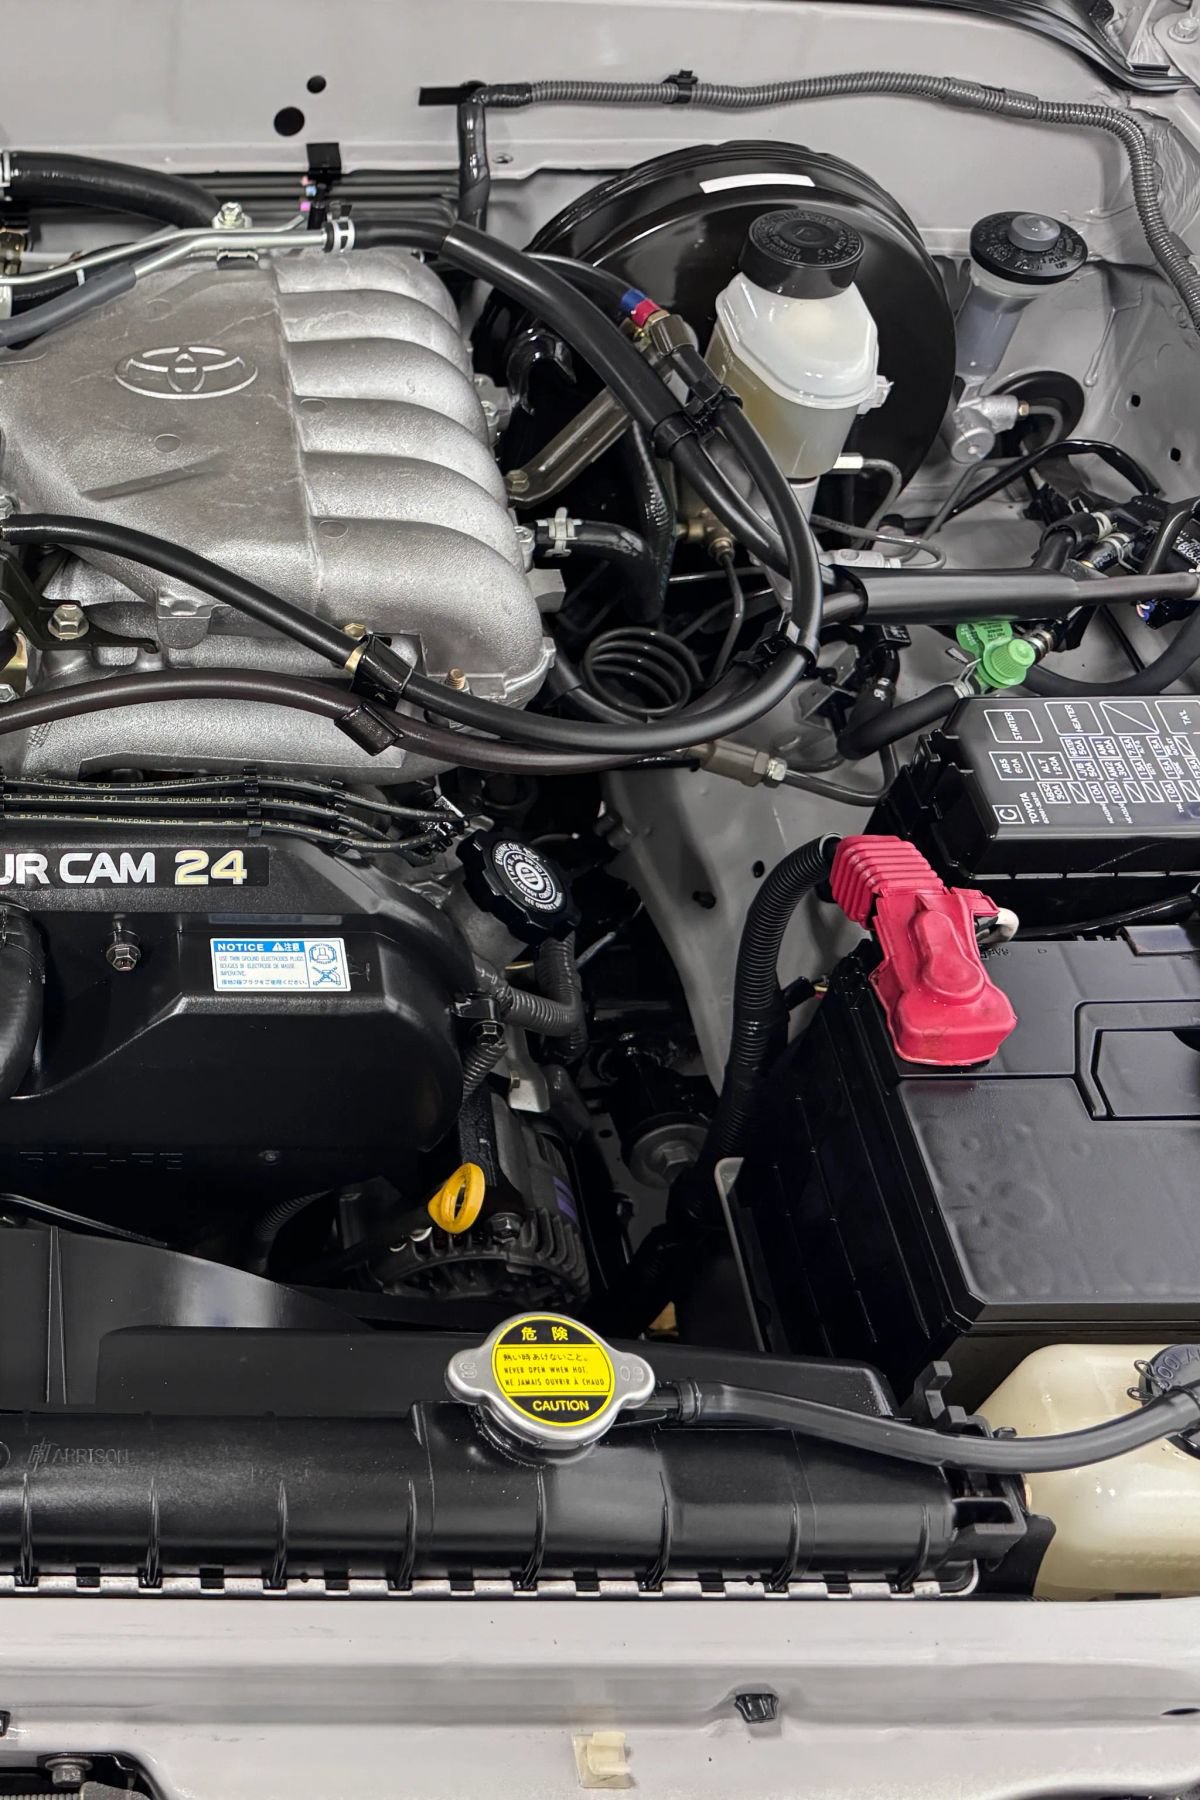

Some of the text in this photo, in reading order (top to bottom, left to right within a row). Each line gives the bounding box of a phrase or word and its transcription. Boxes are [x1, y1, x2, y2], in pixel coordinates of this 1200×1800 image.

[1004, 711, 1022, 741] STARTER
[1064, 705, 1084, 732] HEATER
[998, 758, 1013, 774] ABS
[1011, 758, 1024, 774] 60A
[1037, 759, 1052, 774] ALT
[1048, 756, 1063, 775] 120A
[1090, 784, 1103, 799] 10A
[1109, 784, 1122, 799] 10A
[1165, 783, 1178, 798] 10A
[999, 808, 1018, 821] C
[1019, 792, 1040, 824] TOYOTA
[59, 851, 155, 884] CAM
[174, 849, 248, 885] 24
[217, 943, 265, 951] NOTICE
[504, 1366, 524, 1374] NEVER
[528, 1366, 545, 1374] OPEN
[549, 1366, 569, 1374] WHEN
[517, 1378, 542, 1386] JAMAIS
[532, 1399, 590, 1411] CAUTION
